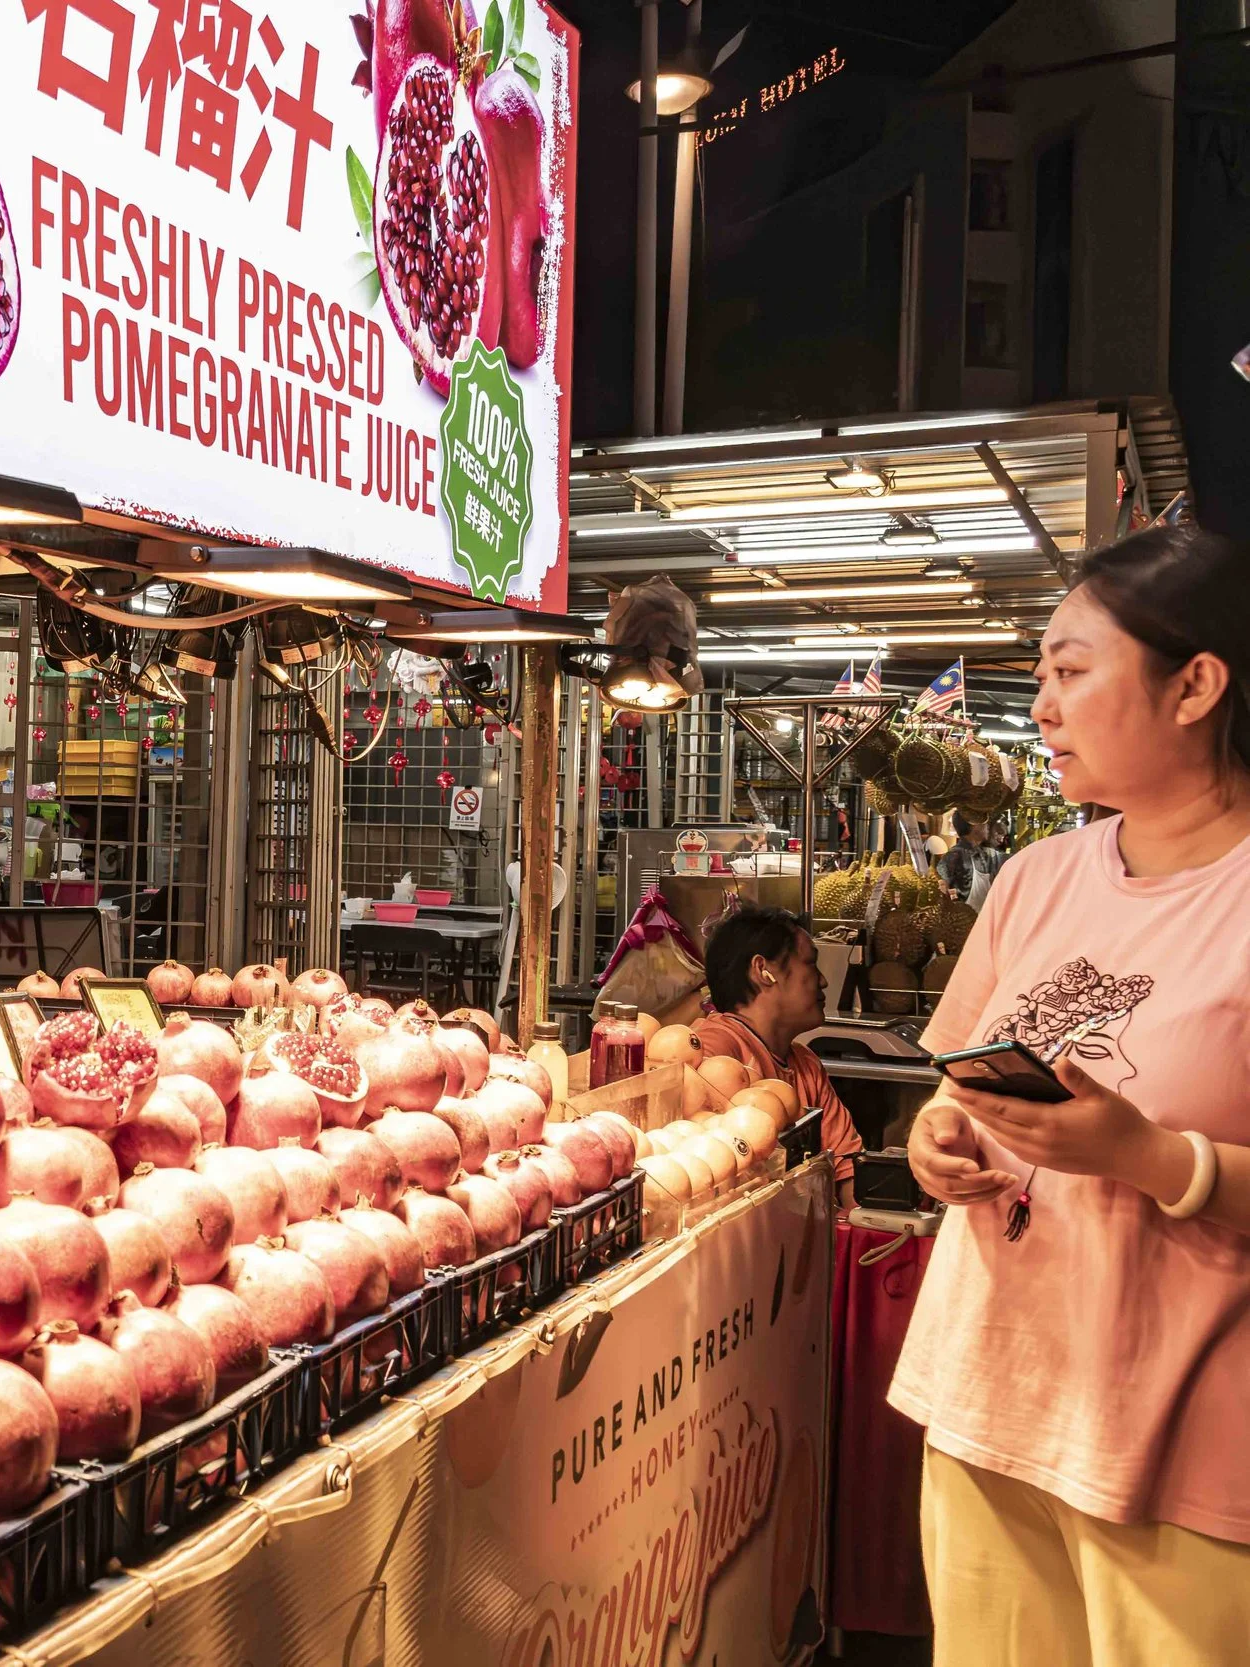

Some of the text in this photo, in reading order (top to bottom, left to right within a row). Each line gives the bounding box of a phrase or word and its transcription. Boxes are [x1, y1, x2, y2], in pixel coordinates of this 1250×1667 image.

[760, 48, 845, 112] HOTEL
[32, 155, 384, 406] FRESHLY PRESSED
[62, 292, 437, 517] POMEGRANATE JUICE
[467, 381, 519, 489] 100%
[452, 438, 521, 525] FRESH JUICE
[463, 489, 504, 553] 鲜果汁
[551, 1297, 754, 1504] PURE AND FRESH
[630, 1408, 700, 1504] HONEY
